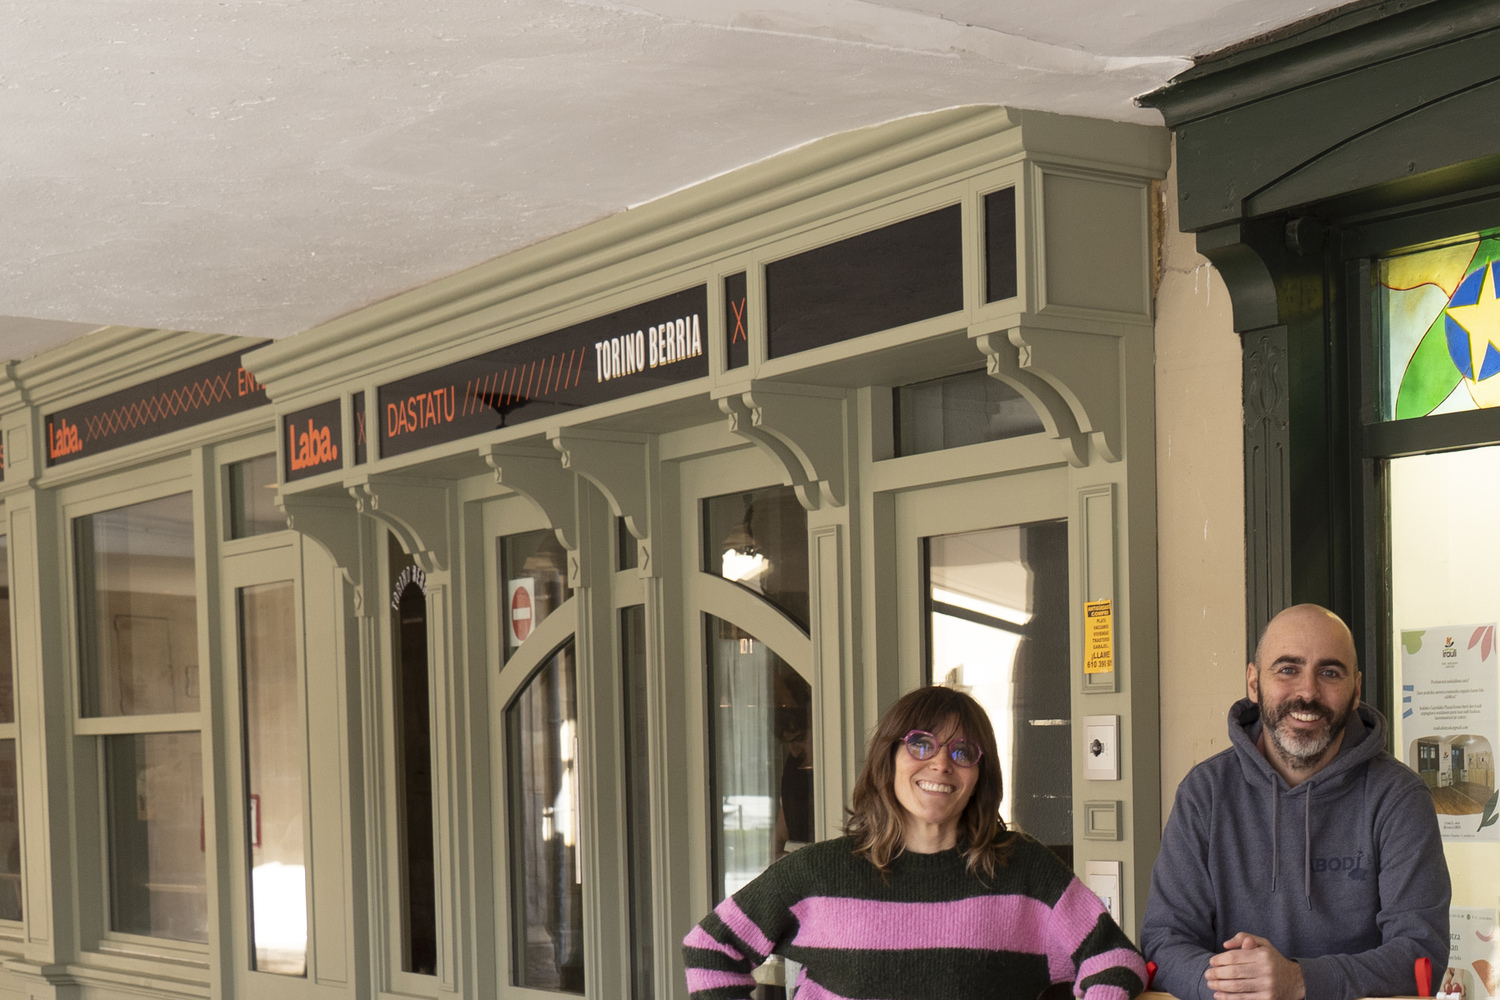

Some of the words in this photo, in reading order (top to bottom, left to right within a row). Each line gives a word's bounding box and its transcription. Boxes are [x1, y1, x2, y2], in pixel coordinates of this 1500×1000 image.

[594, 330, 646, 383] TORINO
[648, 314, 703, 368] BERRIA
[387, 385, 455, 438] DASTATU
[49, 418, 83, 459] Laba.
[289, 418, 338, 471] Laba.
